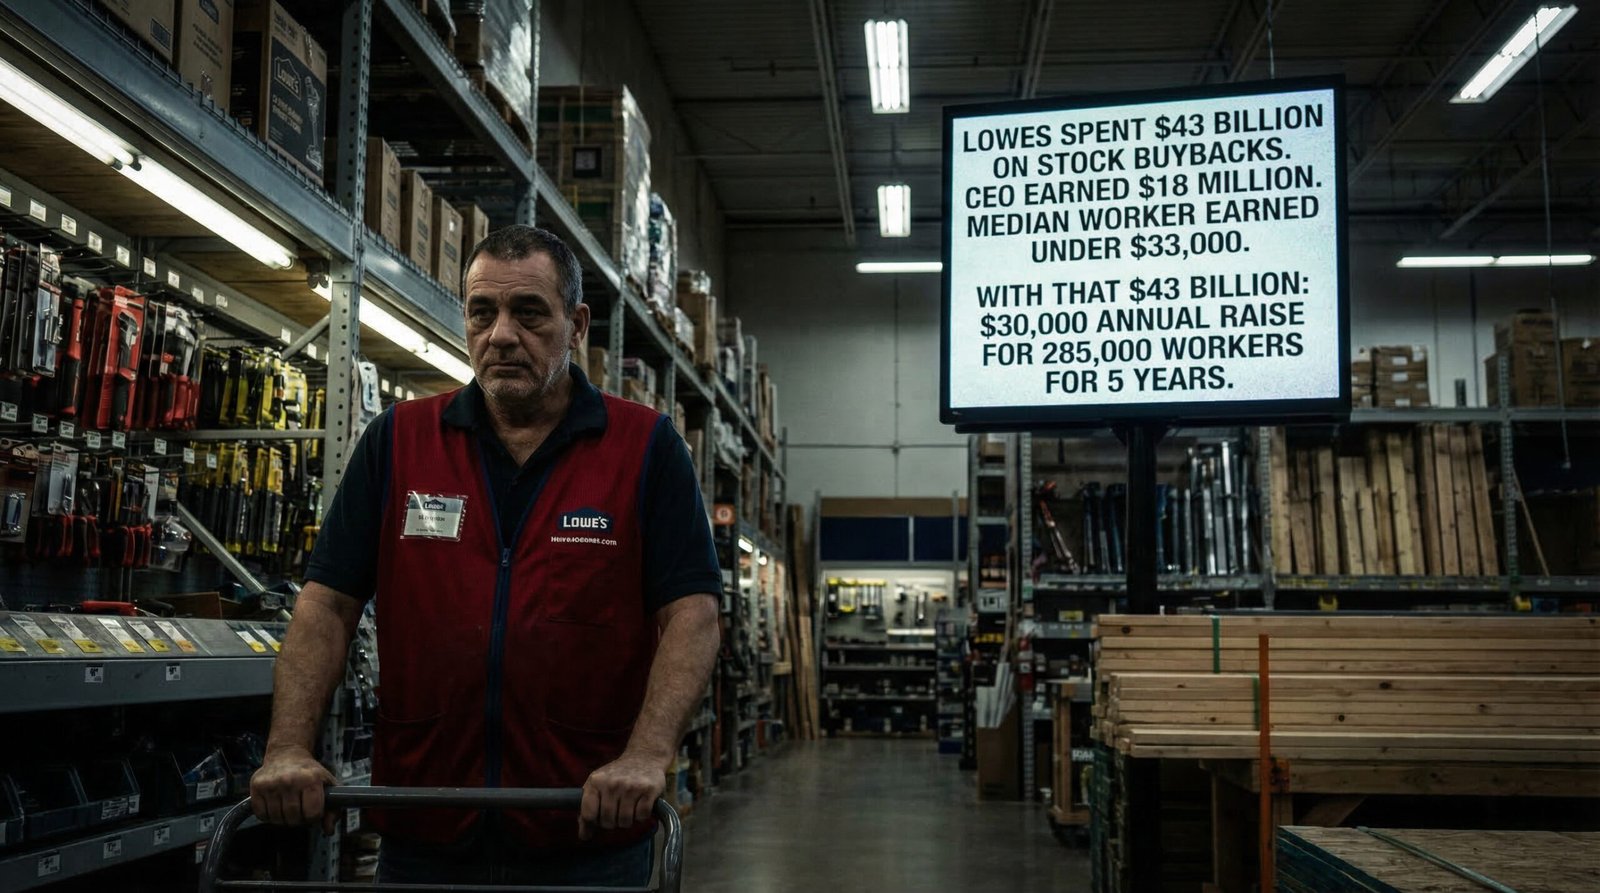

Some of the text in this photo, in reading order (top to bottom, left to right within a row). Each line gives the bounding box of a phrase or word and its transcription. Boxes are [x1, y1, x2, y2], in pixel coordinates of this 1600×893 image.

[963, 103, 1323, 153] LOWES SPENT $43 BILLION
[993, 136, 1291, 179] ON STOCK BUYBACKS.
[965, 164, 1322, 209] CEO EARNED $18 MILLION.
[967, 195, 1319, 238] MEDIAN WORKER EARNED
[1031, 230, 1250, 263] UNDER $33,000.
[976, 271, 1309, 308] WITH THAT $43 BILLION:
[980, 301, 1305, 340] $30,000 ANNUAL RAISE
[983, 332, 1304, 368] FOR 285,000 WORKERS
[1046, 365, 1234, 394] FOR 5 YEARS.
[563, 515, 608, 529] LOWE'S
